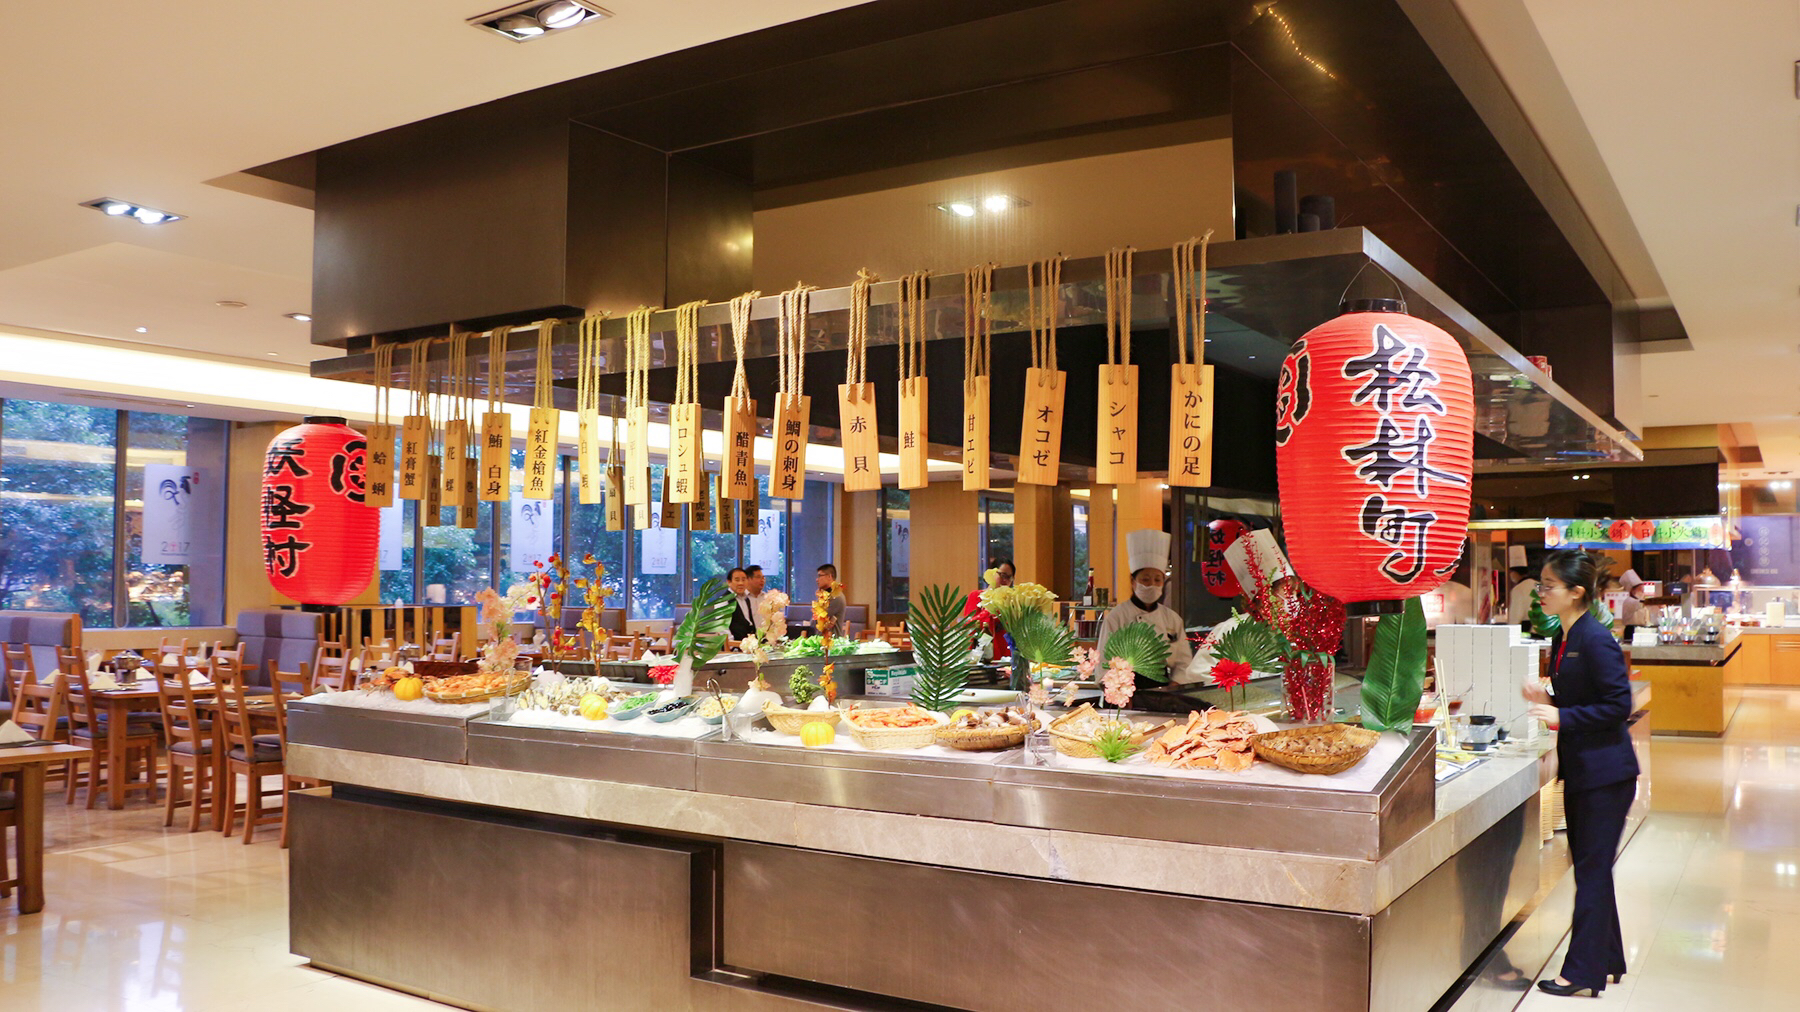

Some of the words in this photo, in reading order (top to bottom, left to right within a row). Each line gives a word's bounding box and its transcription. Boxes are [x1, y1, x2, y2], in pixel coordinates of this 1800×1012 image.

[530, 428, 549, 492] 紅金槍魚
[782, 419, 801, 491] 鯛の刺身
[849, 416, 870, 473] 赤貝
[903, 430, 915, 449] 鮭
[966, 414, 976, 474] 甘エビ
[1033, 405, 1054, 467] オコゼ
[1109, 401, 1127, 465] シャコ
[1182, 390, 1203, 476] かにの足
